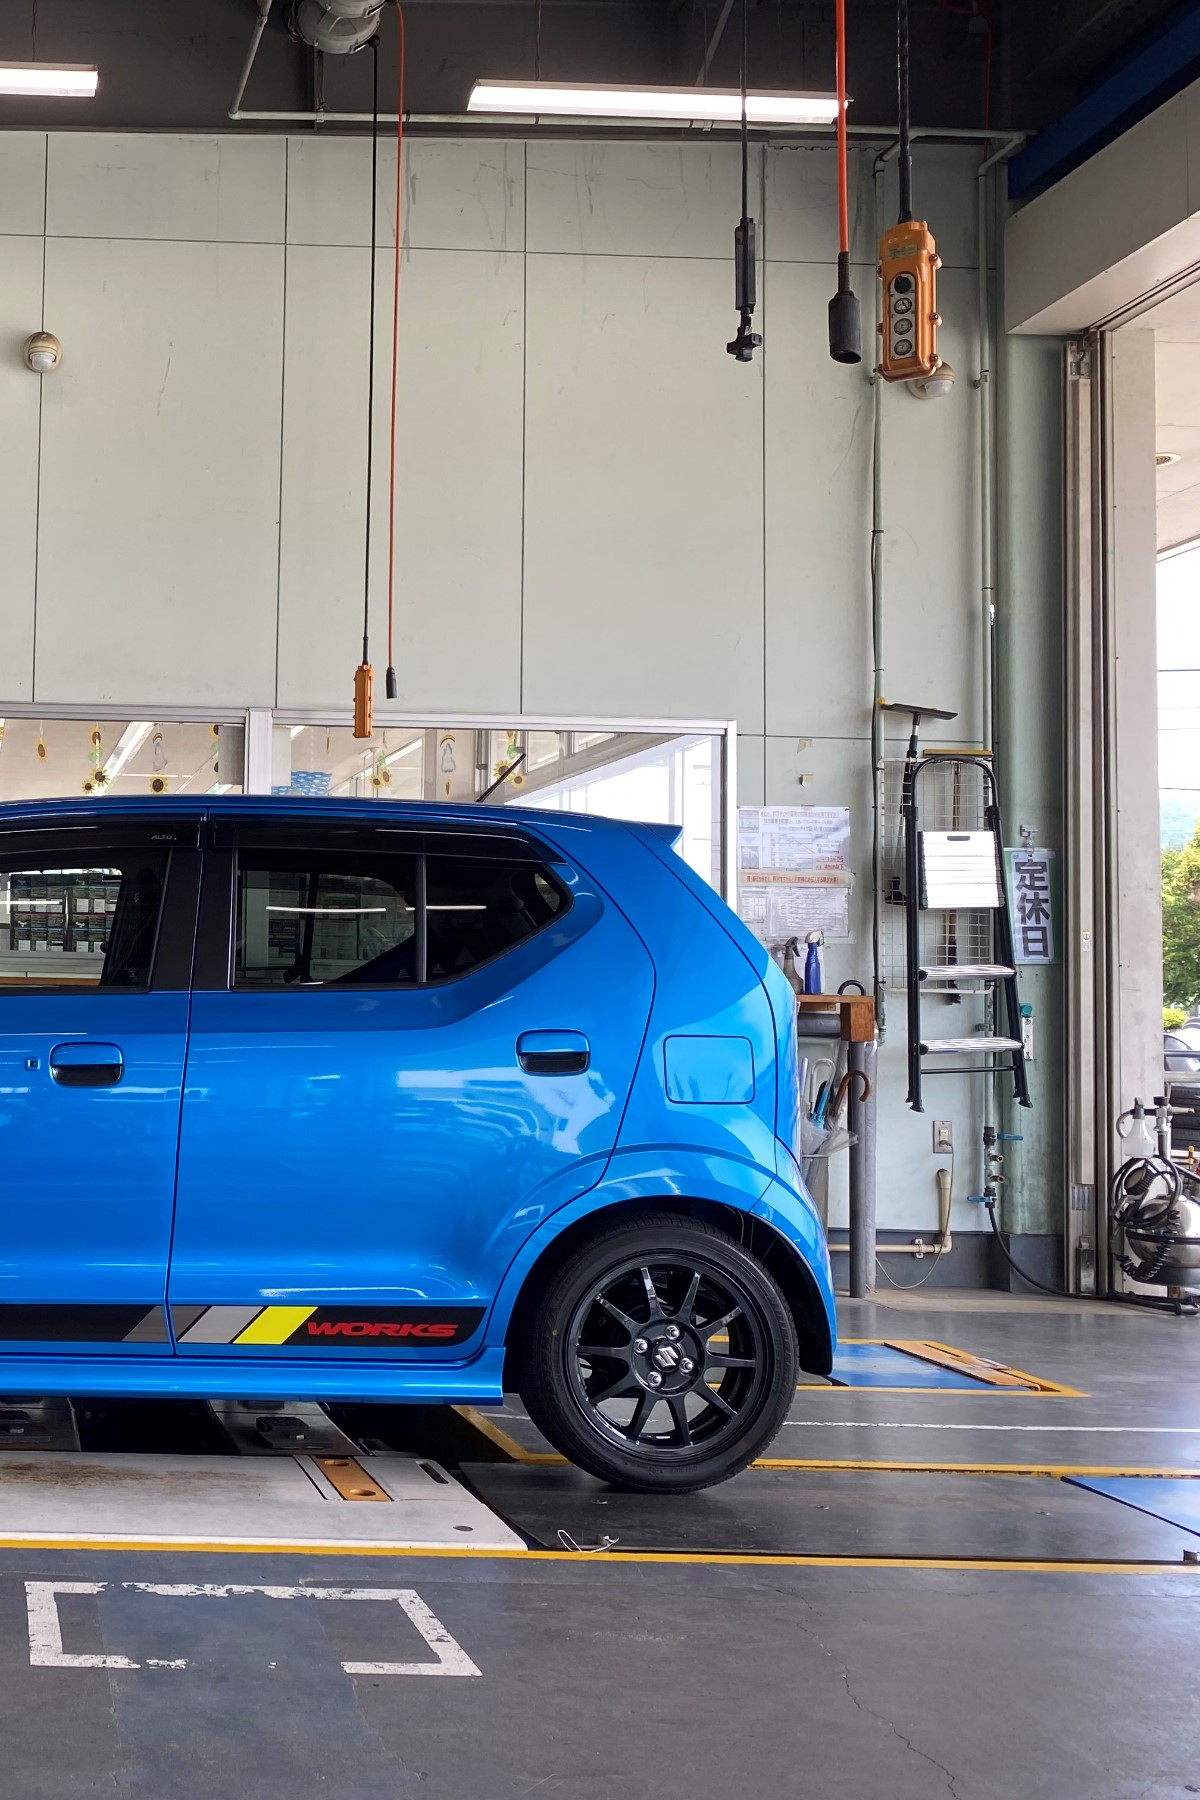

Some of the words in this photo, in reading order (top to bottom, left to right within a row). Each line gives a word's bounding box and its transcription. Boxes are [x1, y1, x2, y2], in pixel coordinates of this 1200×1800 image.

[1014, 859, 1051, 958] 定休日
[307, 1322, 459, 1337] WORKS
